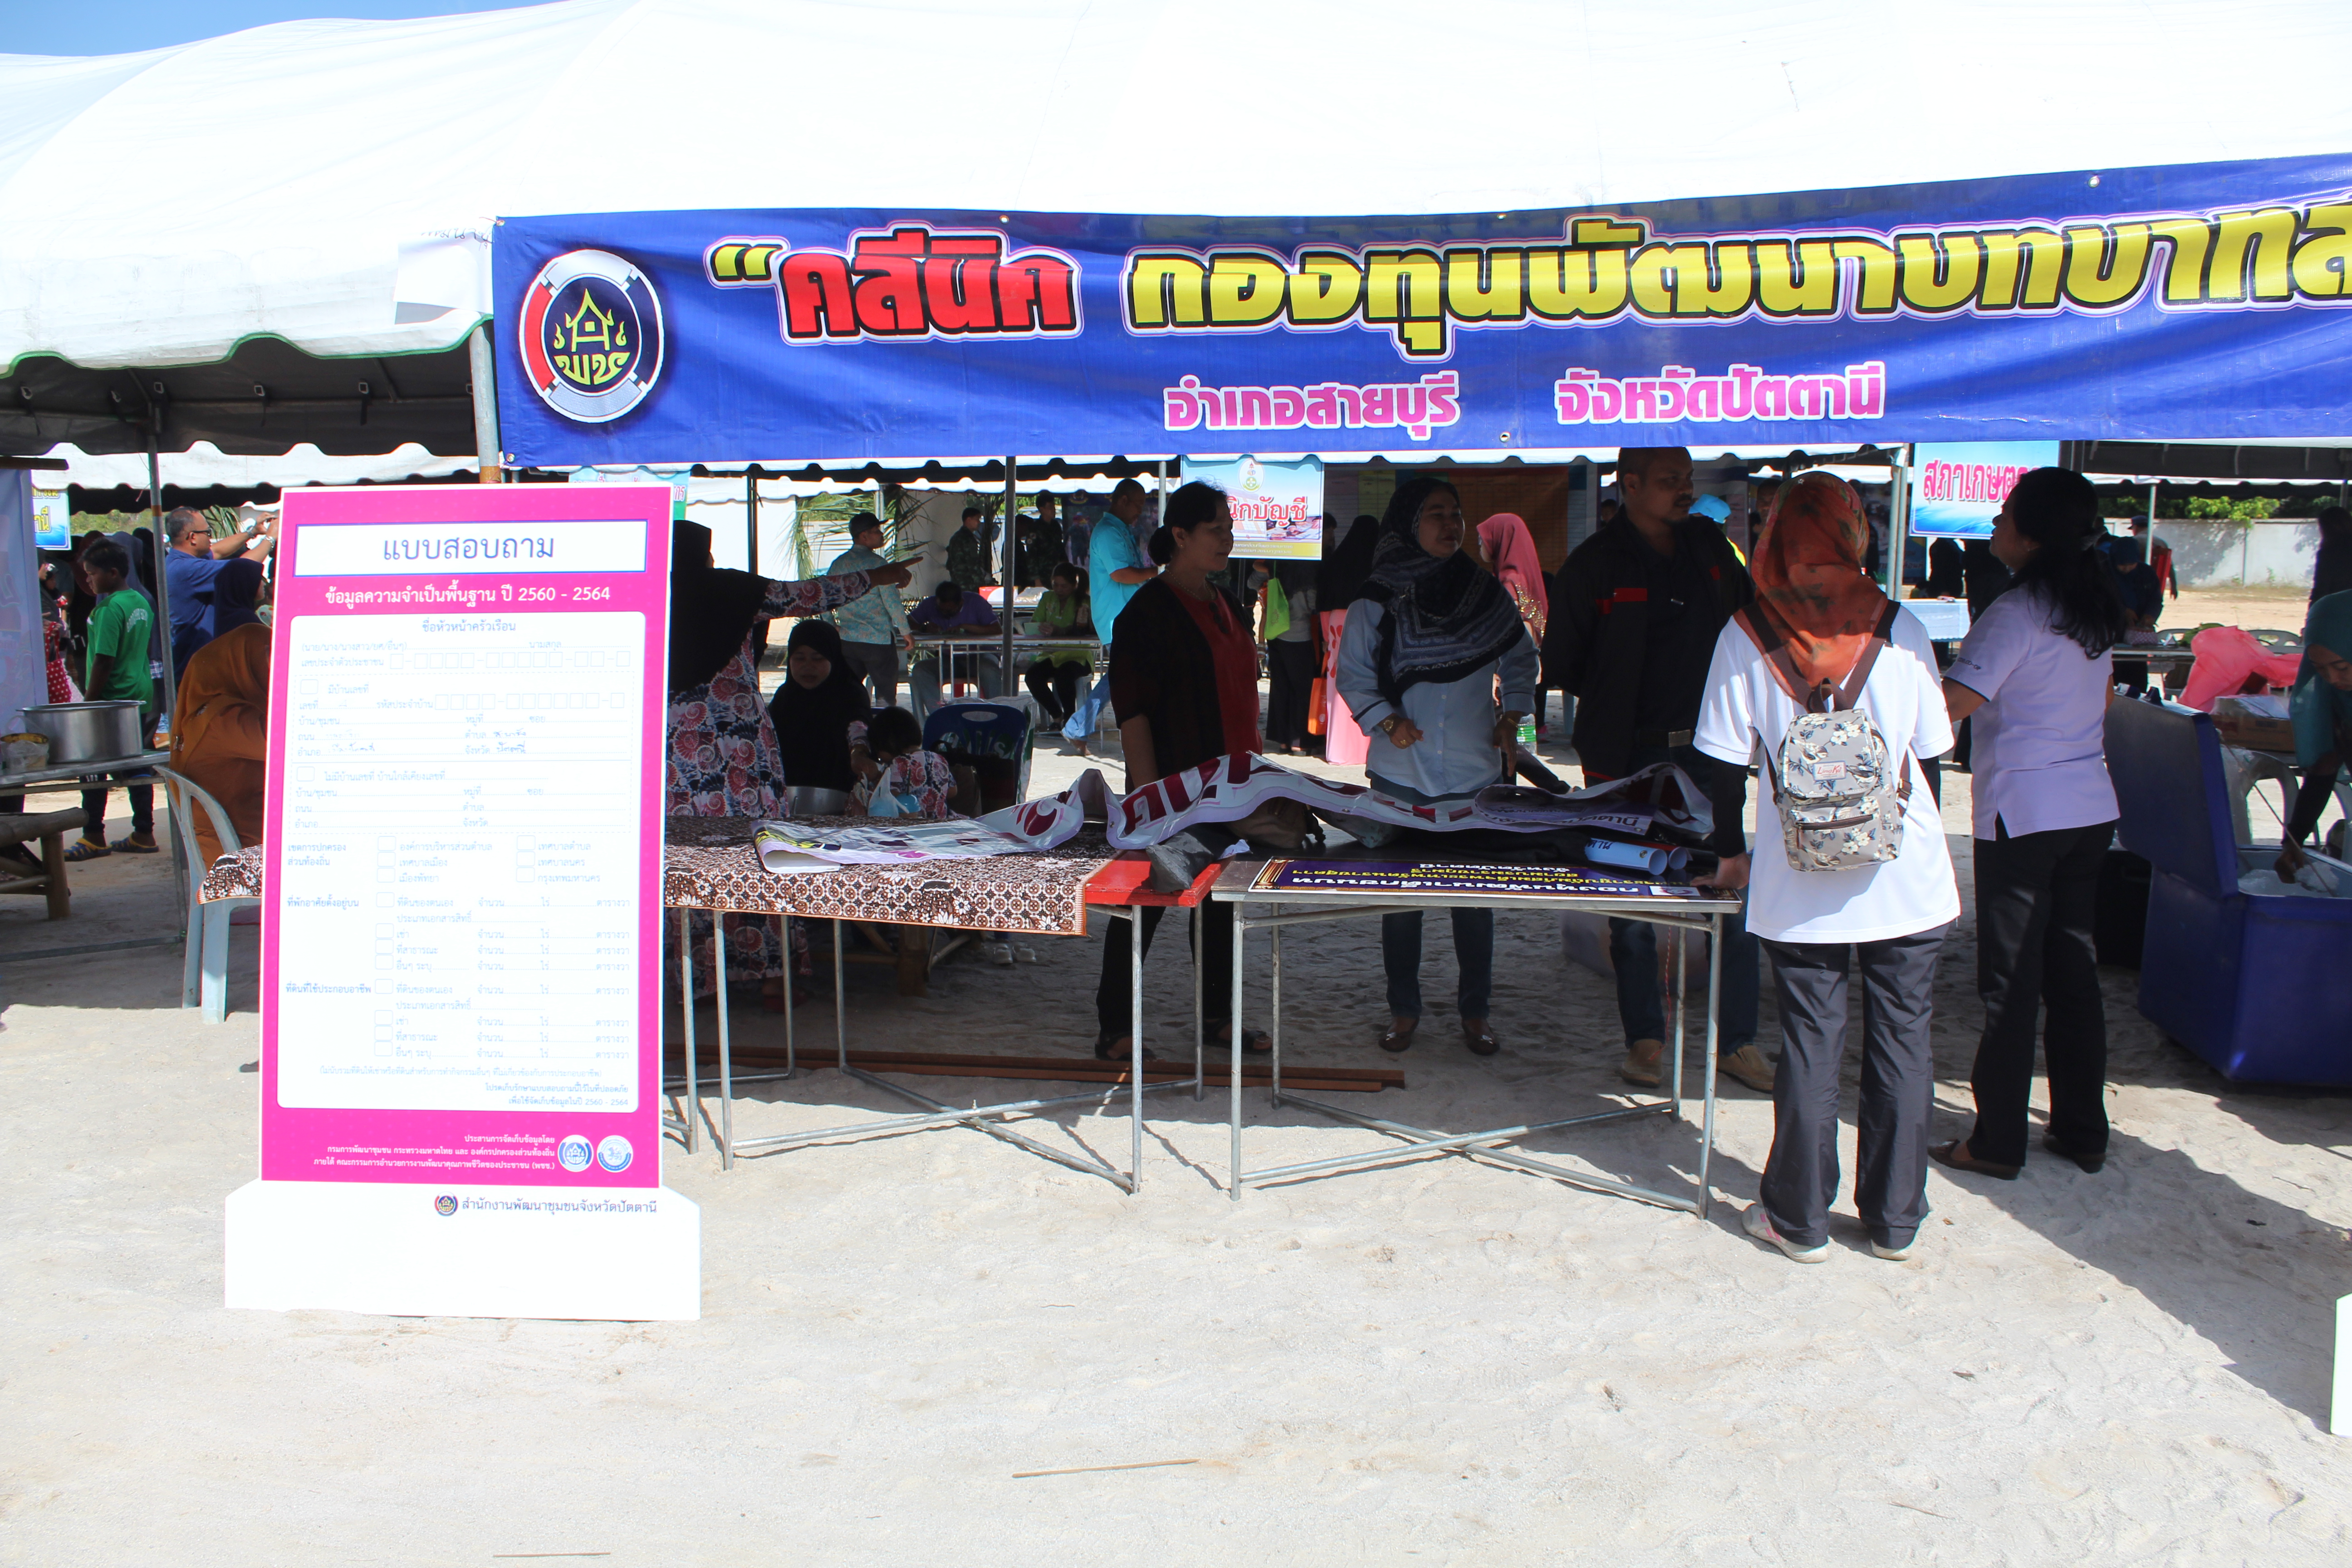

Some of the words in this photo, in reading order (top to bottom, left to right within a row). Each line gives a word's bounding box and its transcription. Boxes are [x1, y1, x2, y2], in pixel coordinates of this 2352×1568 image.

[1164, 370, 1461, 441] อำเภอสายบุรี
[1555, 361, 1887, 425] จังหวัดปัตตานี
[384, 536, 554, 561] แบบสอบถาม
[325, 579, 495, 609] ข้อมูลความจำเป็นพื้นฐาน
[501, 583, 512, 602] ปี
[518, 587, 556, 602] 2560
[573, 586, 611, 601] 2564
[422, 618, 516, 632] ชื่อหัวหน้าครัวเรือน
[529, 641, 561, 651] นามสกุล
[301, 657, 384, 667] เลขประจำตัวประชาชน
[328, 682, 369, 694] มีบ้านเลขที่
[299, 699, 318, 709] เลขที่
[377, 698, 433, 709] รหัสประจำบ้าน
[299, 716, 340, 727] บ้าน/ชุมชน
[465, 712, 484, 726] หมู่ที่
[465, 730, 486, 739] ตำบล
[297, 747, 321, 757] อำเภอ
[465, 745, 490, 755] จังหวัด
[324, 769, 374, 781] ไม่มีบ้านเลขที่
[377, 769, 445, 780] บ้านใกล้เคียงเลขที่
[295, 788, 337, 799] บ้าน/ชุมชน
[463, 784, 481, 799] หมู่ที่
[463, 802, 485, 812] ตำบล
[295, 819, 318, 828] อำเภอ
[463, 818, 489, 827] จังหวัด
[288, 843, 346, 852] เขตการปกครอง
[400, 841, 492, 851] องค์การบริหารส่วนตำบล
[538, 840, 591, 851] เทศบาลตำบล
[287, 855, 330, 866] ส่วนท้องถิ่น
[399, 857, 447, 867] เทศบาลเมือง
[538, 858, 585, 867] เทศบาลนคร
[399, 873, 439, 883] เมืองพัทยา
[538, 874, 600, 885] กรุงเทพมหานคร
[286, 894, 359, 910] ที่พักอาศัยตั้งอยู่บน
[397, 896, 453, 907] ที่ดินของตนเอง
[478, 897, 505, 907] จำนวน
[541, 897, 550, 906] ไร่
[596, 899, 630, 907] ตารางวา
[397, 911, 472, 923] ประเภทเอกสารสิทธิ์
[397, 930, 409, 938] เช่า
[478, 929, 504, 939] จำนวน
[540, 928, 549, 938] ไร่
[596, 931, 630, 939] ตารางวา
[396, 942, 439, 954] ที่สาธารณะ
[477, 945, 504, 955] จำนวน
[540, 944, 549, 954] ไร่
[596, 946, 630, 955] ตารางวา
[416, 962, 432, 972] ระบุ
[477, 960, 504, 970] จำนวน
[540, 960, 549, 970] ไร่
[596, 963, 630, 971] ตารางวา
[285, 981, 371, 993] ที่ดินที่ใช้ประกอบอาชีพ
[396, 983, 453, 994] ที่ดินของตนเอง
[477, 984, 504, 994] จำนวน
[540, 984, 549, 994] ไร่
[596, 986, 630, 995] ตารางวา
[396, 998, 471, 1010] ประเภทเอกสารสิทธิ์
[396, 1017, 408, 1025] เช่า
[477, 1016, 504, 1026] จำนวน
[540, 1016, 549, 1026] ไร่
[595, 1019, 629, 1027] ตารางวา
[396, 1029, 438, 1041] ที่สาธารณะ
[477, 1032, 504, 1042] จำนวน
[539, 1032, 549, 1042] ไร่
[595, 1034, 629, 1043] ตารางวา
[416, 1049, 431, 1059] ระบุ
[476, 1048, 503, 1058] จำนวน
[539, 1048, 549, 1058] ไร่
[595, 1051, 629, 1059] ตารางวา
[464, 1134, 555, 1146] ประสานการจัดเก็บข้อมูลโดย
[327, 1145, 391, 1156] กรมการพัฒนาชุมชน
[393, 1146, 453, 1155] กระทรวงมหาดไทย
[470, 1145, 555, 1156] องค์กรปกครองส่วนท้องถิ่น
[314, 1156, 334, 1166] ภายใต้
[462, 1197, 657, 1215] สำนักงานพัฒนาชุมชนจังหวัดปัตตานี
